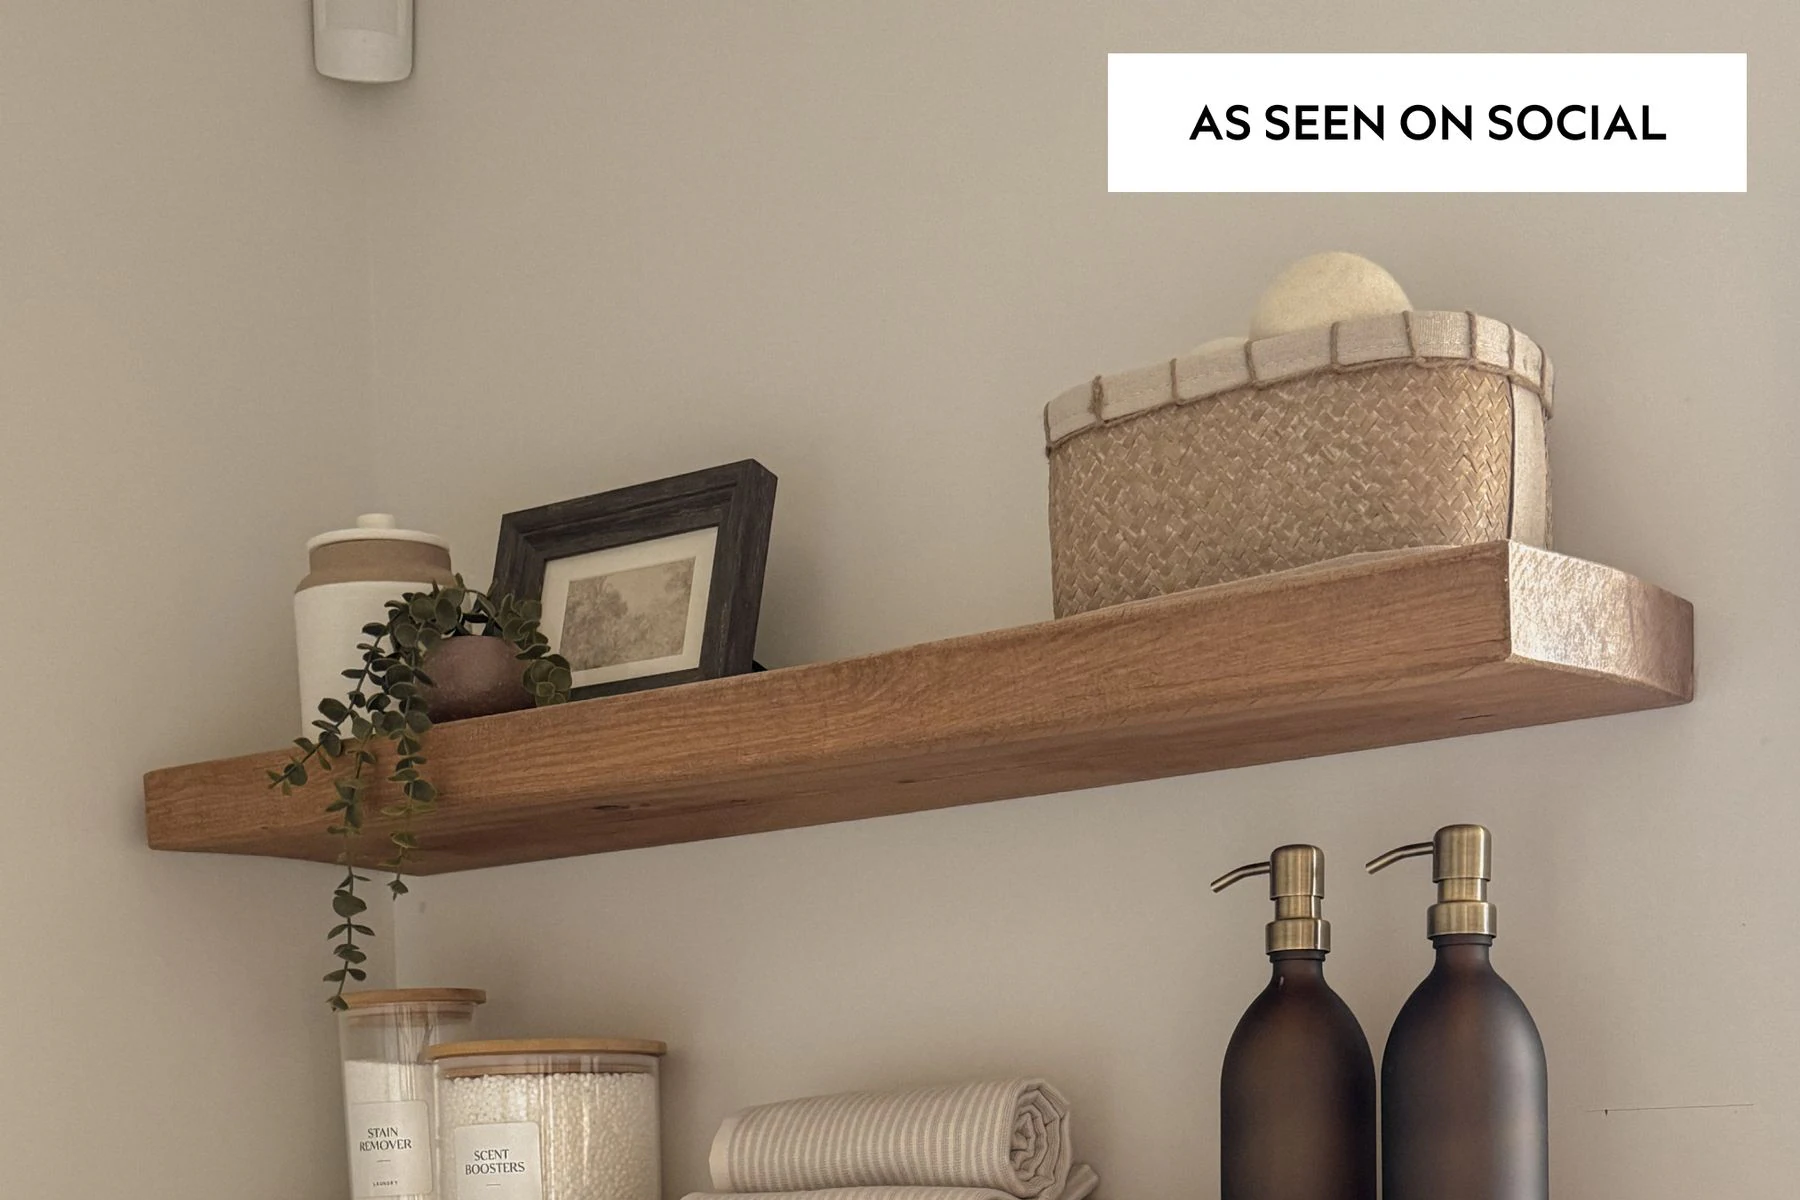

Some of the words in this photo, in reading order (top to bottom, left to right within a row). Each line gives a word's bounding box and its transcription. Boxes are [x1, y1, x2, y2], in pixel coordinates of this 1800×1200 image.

[367, 1127, 399, 1139] STAIN
[359, 1138, 413, 1152] REMOVER
[473, 1148, 510, 1162] SCENT
[465, 1161, 526, 1176] BOOSTERS
